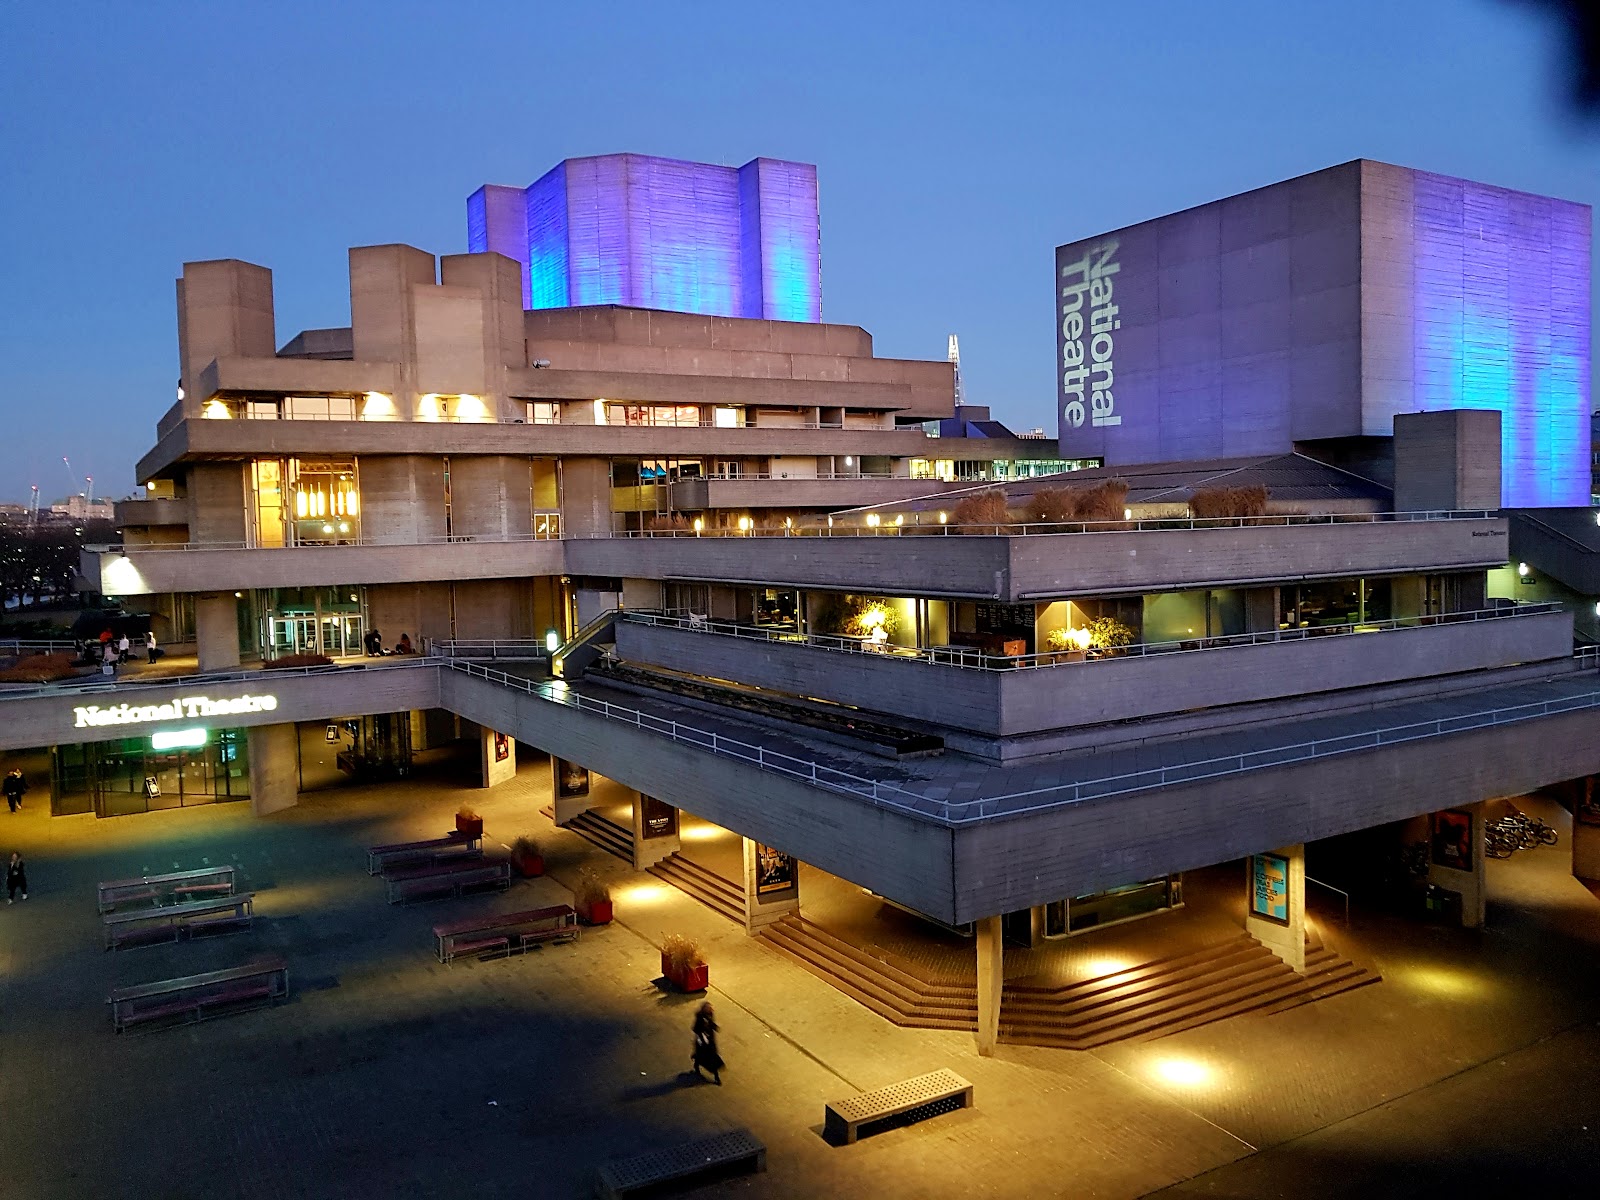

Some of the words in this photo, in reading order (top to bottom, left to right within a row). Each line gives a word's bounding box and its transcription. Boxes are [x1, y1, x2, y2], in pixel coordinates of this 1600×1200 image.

[1062, 253, 1092, 429] Theatre
[1090, 238, 1121, 427] National
[73, 699, 183, 728] National
[182, 695, 277, 718] Theatre
